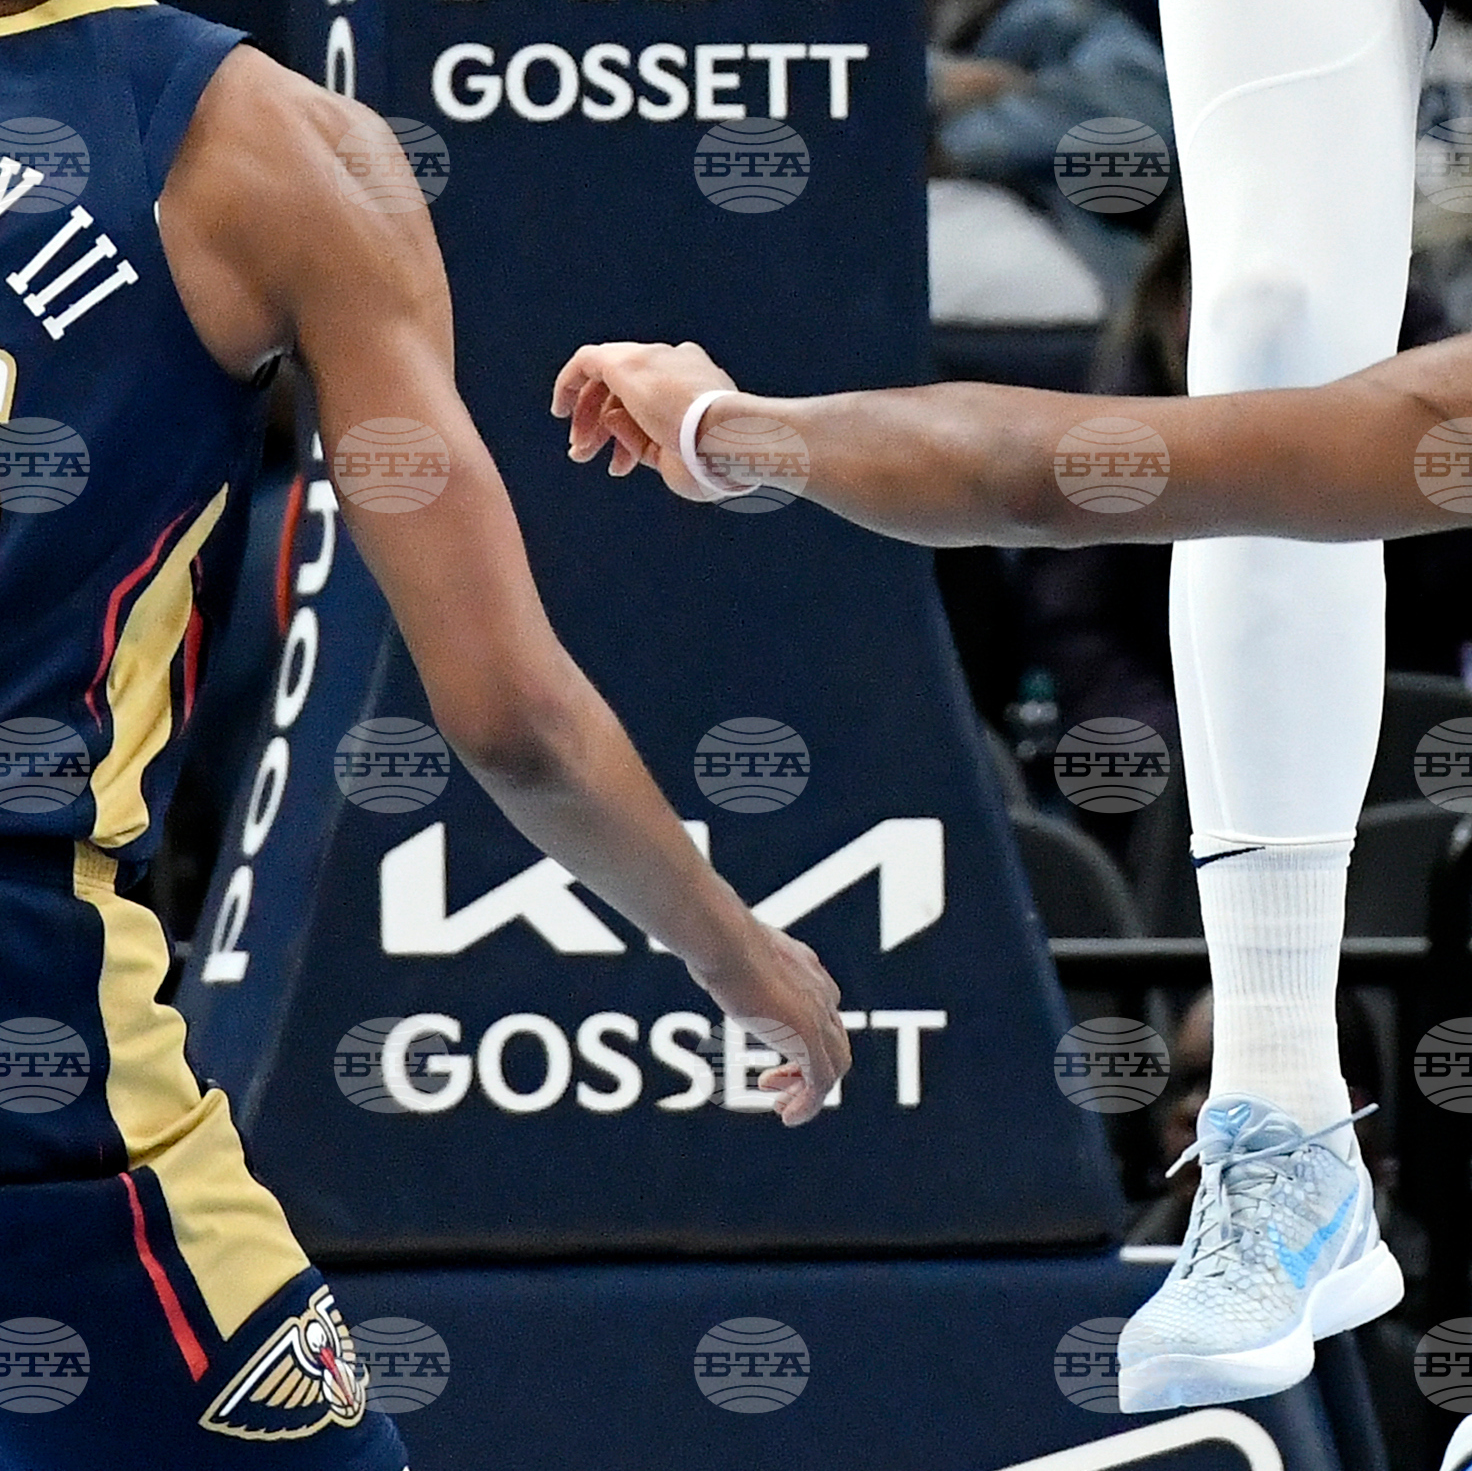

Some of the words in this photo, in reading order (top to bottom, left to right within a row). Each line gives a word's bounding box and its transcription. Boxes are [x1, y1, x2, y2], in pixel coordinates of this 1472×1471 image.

[431, 42, 869, 122] GOSSETT
[6, 205, 139, 340] III
[380, 817, 945, 954] KA
